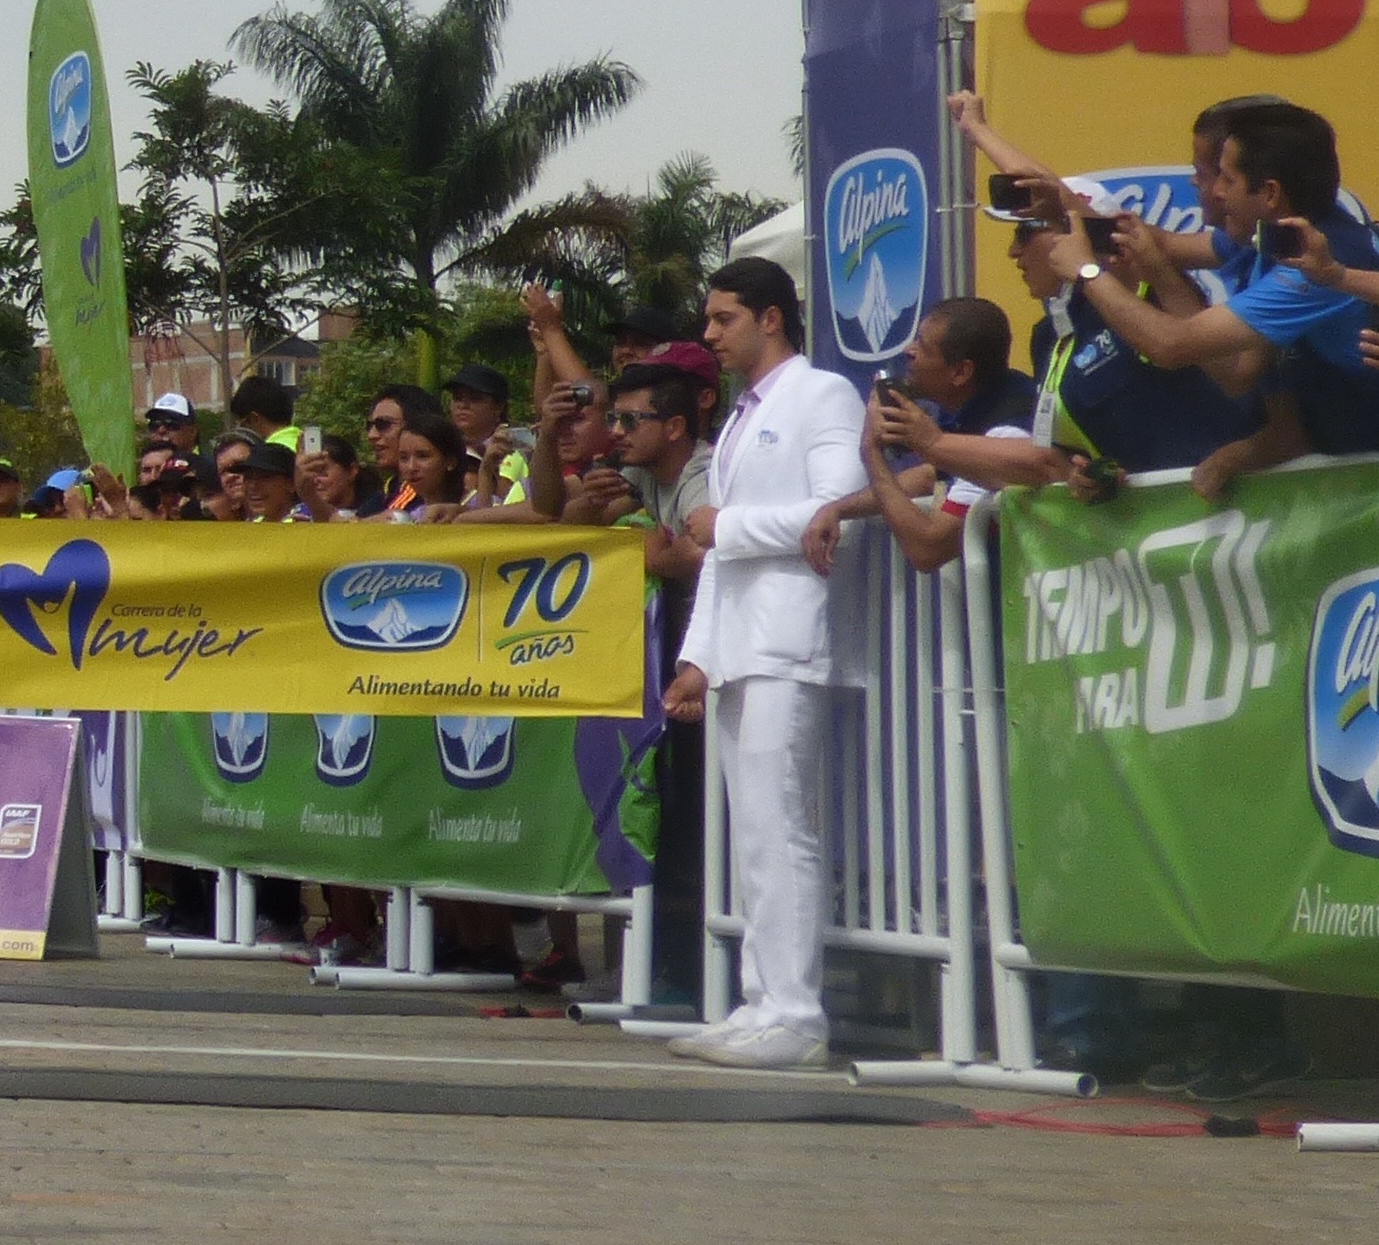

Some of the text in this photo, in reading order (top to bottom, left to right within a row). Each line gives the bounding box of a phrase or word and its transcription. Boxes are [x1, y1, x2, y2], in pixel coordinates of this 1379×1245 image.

[839, 169, 909, 264] Alpina
[343, 567, 441, 604] Alpina
[498, 552, 590, 628] 70
[111, 603, 202, 618] Carrera de la
[89, 619, 264, 681] mujer
[510, 632, 574, 666] años
[347, 675, 560, 699] Alimentando tu vida
